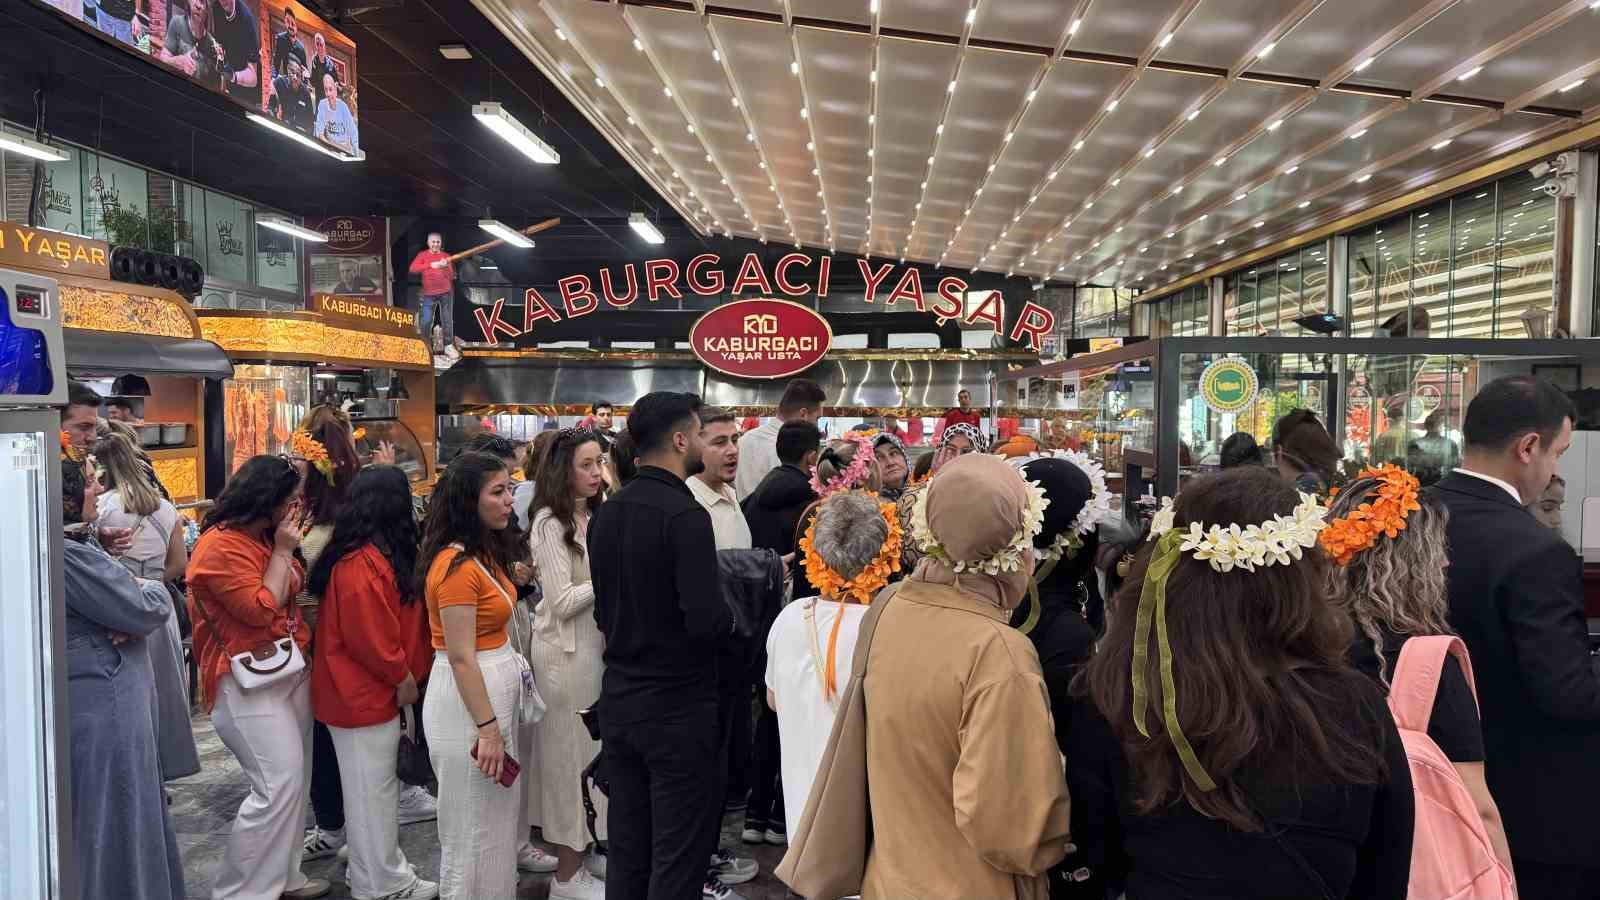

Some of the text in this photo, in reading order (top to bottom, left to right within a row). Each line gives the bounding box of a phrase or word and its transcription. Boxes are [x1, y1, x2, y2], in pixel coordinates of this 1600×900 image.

[15, 229, 105, 268] YAŞAR
[322, 295, 414, 327] KABURGACI YAŞAR
[473, 253, 1055, 351] KABURGACI YAŞAR
[704, 336, 818, 351] KABURGACI
[721, 352, 801, 363] YAŞAR USTA
